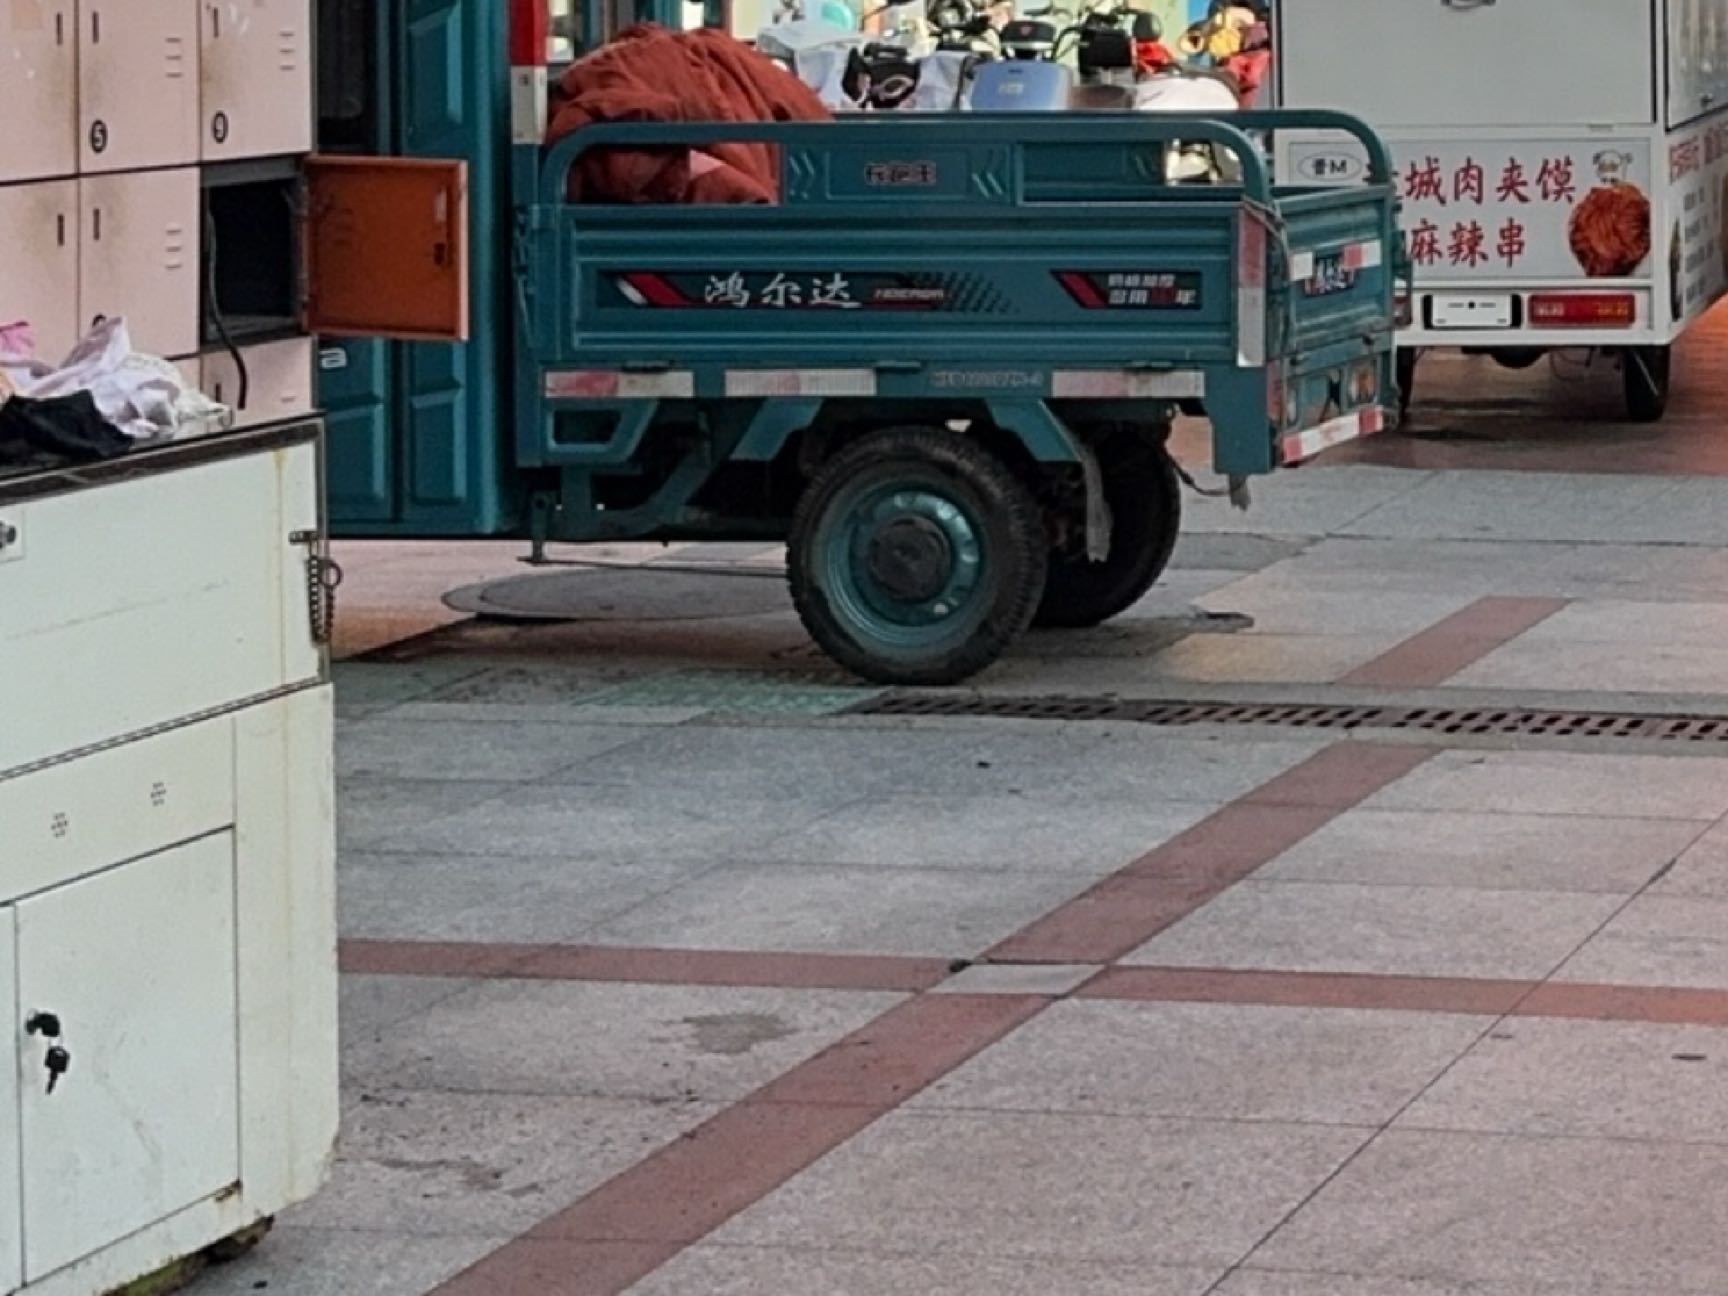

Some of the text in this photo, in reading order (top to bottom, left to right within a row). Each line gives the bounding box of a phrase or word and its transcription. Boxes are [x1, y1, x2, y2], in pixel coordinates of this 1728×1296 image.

[1411, 218, 1526, 268] 麻辣串
[705, 272, 862, 308] 鸿尔达
